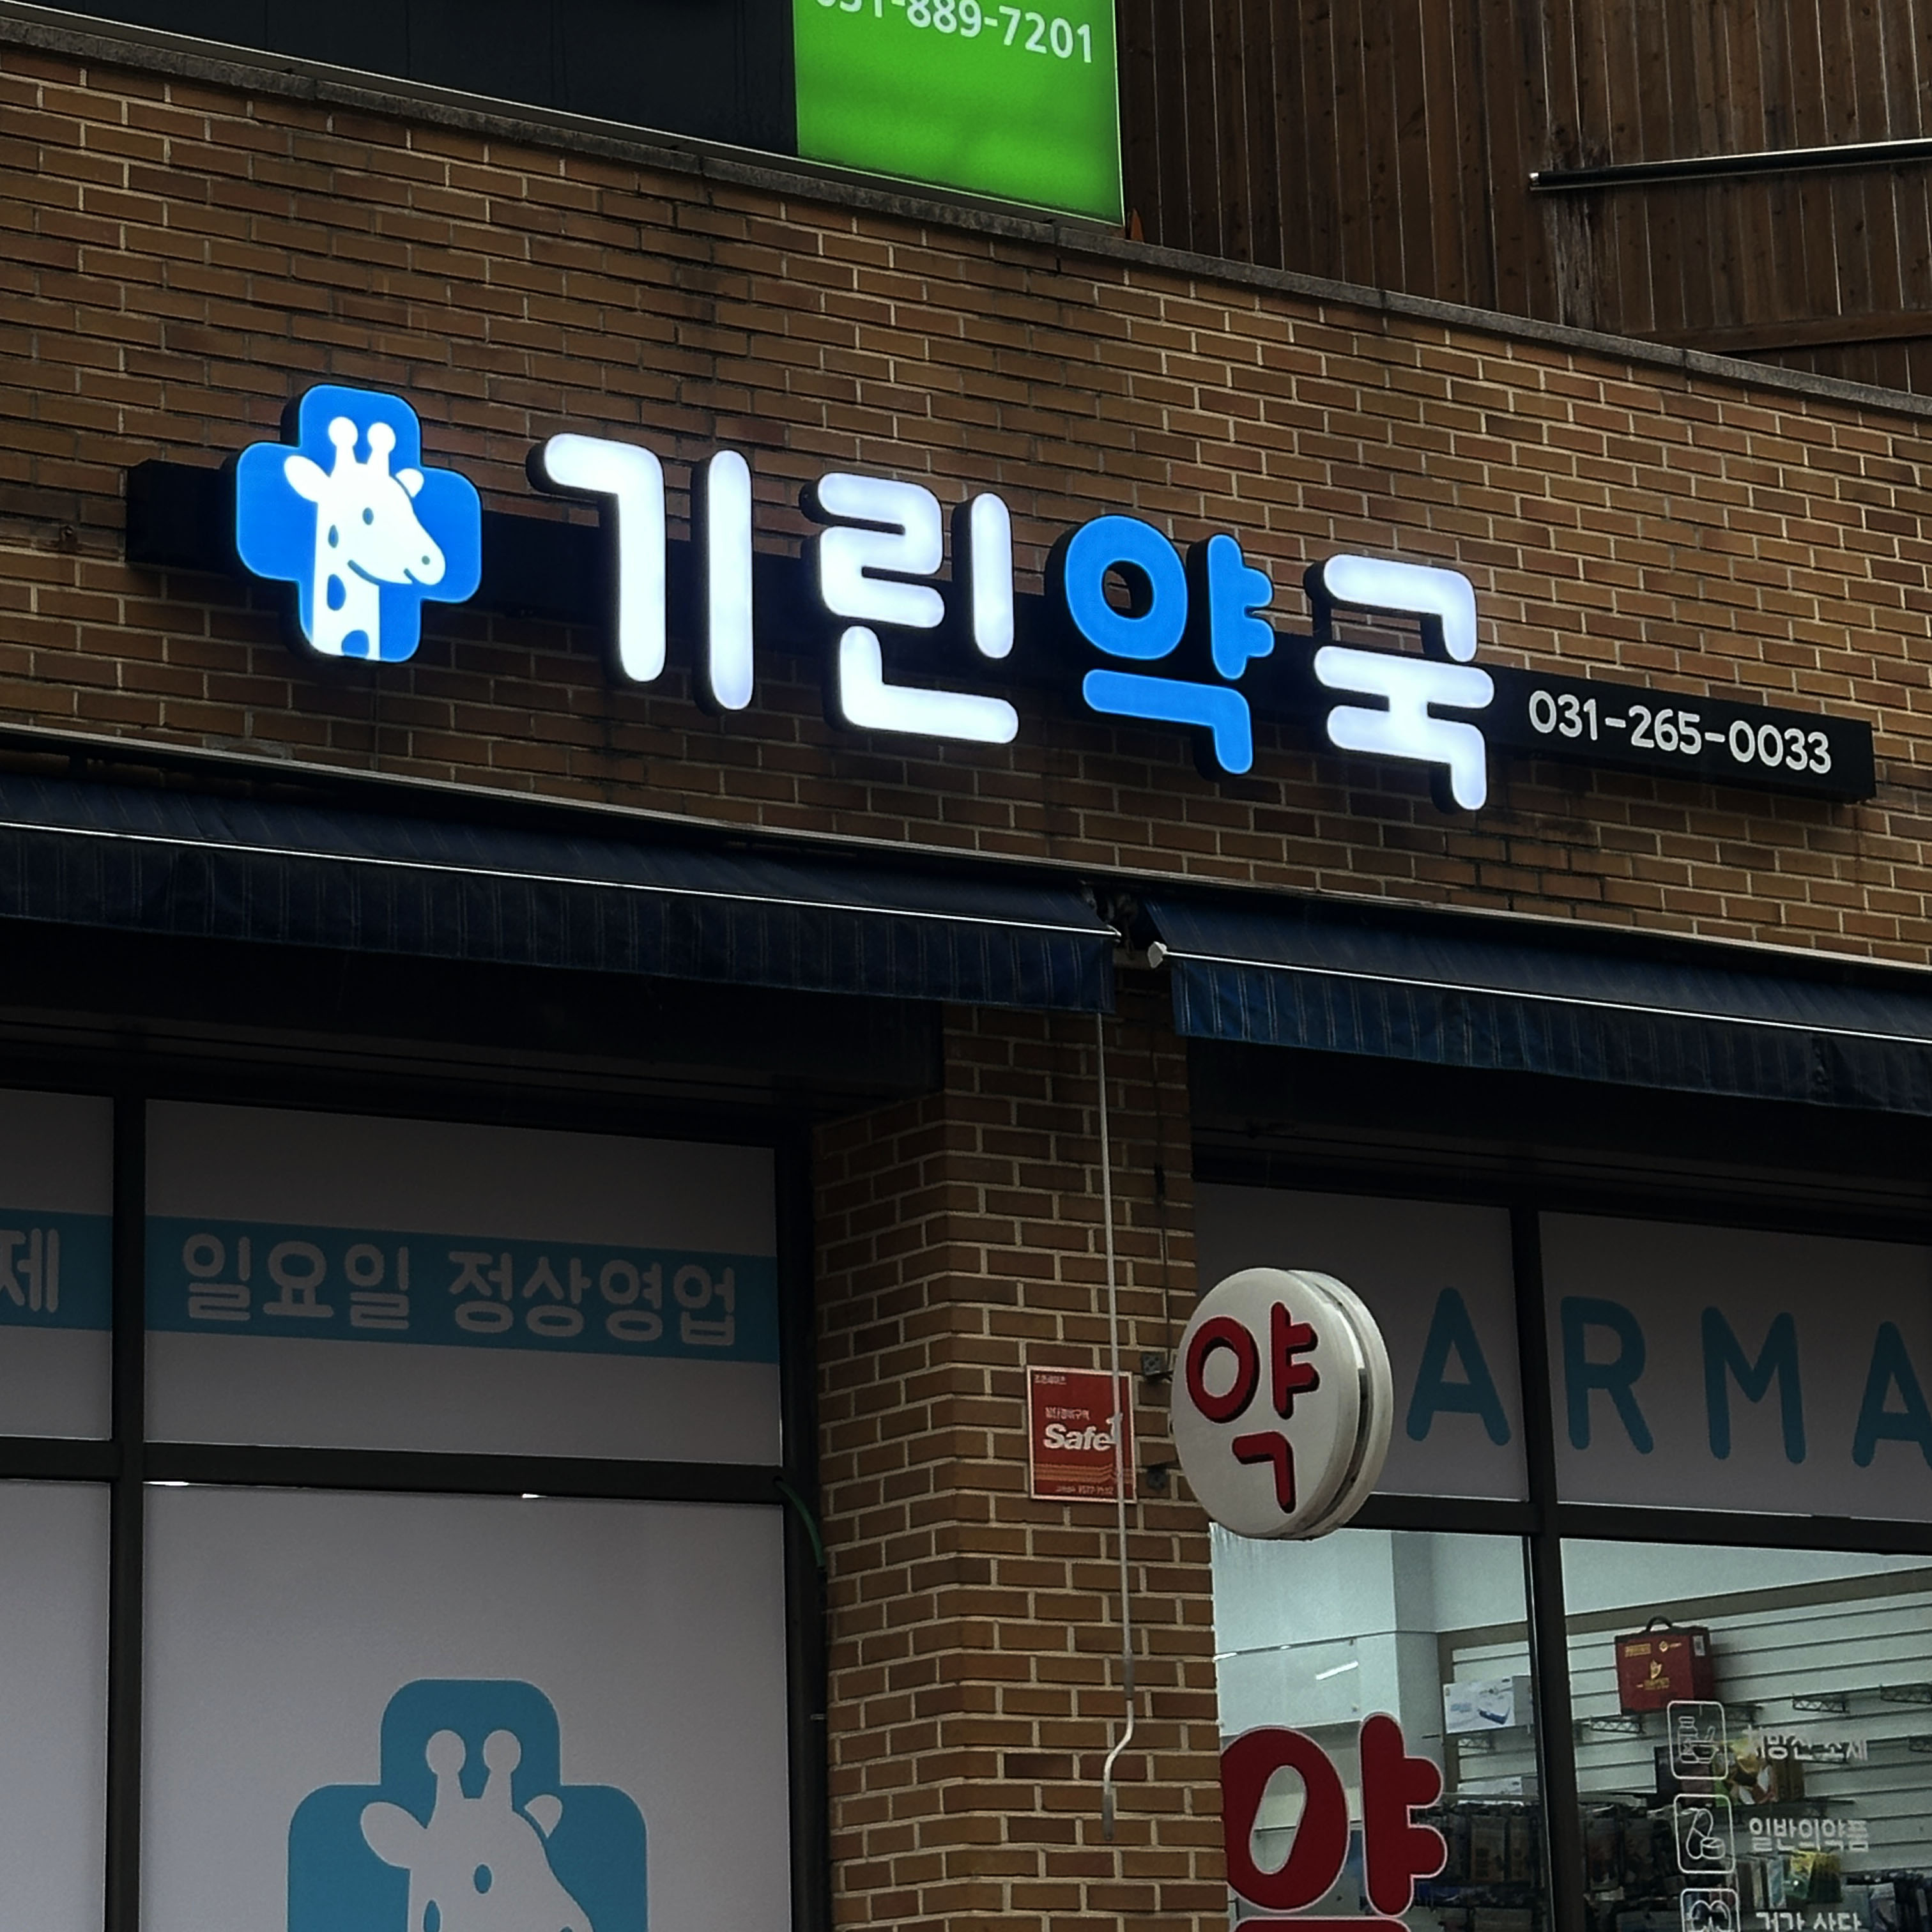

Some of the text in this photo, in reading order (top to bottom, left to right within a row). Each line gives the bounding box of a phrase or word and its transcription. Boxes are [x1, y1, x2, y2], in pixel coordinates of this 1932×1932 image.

[543, 432, 1495, 811] 기린약국
[1529, 690, 1832, 774] 031-265-0033
[182, 1232, 737, 1346] 일요일 정상영업
[1185, 1301, 1319, 1514] 약
[1749, 1817, 1869, 1852] 일반의약품
